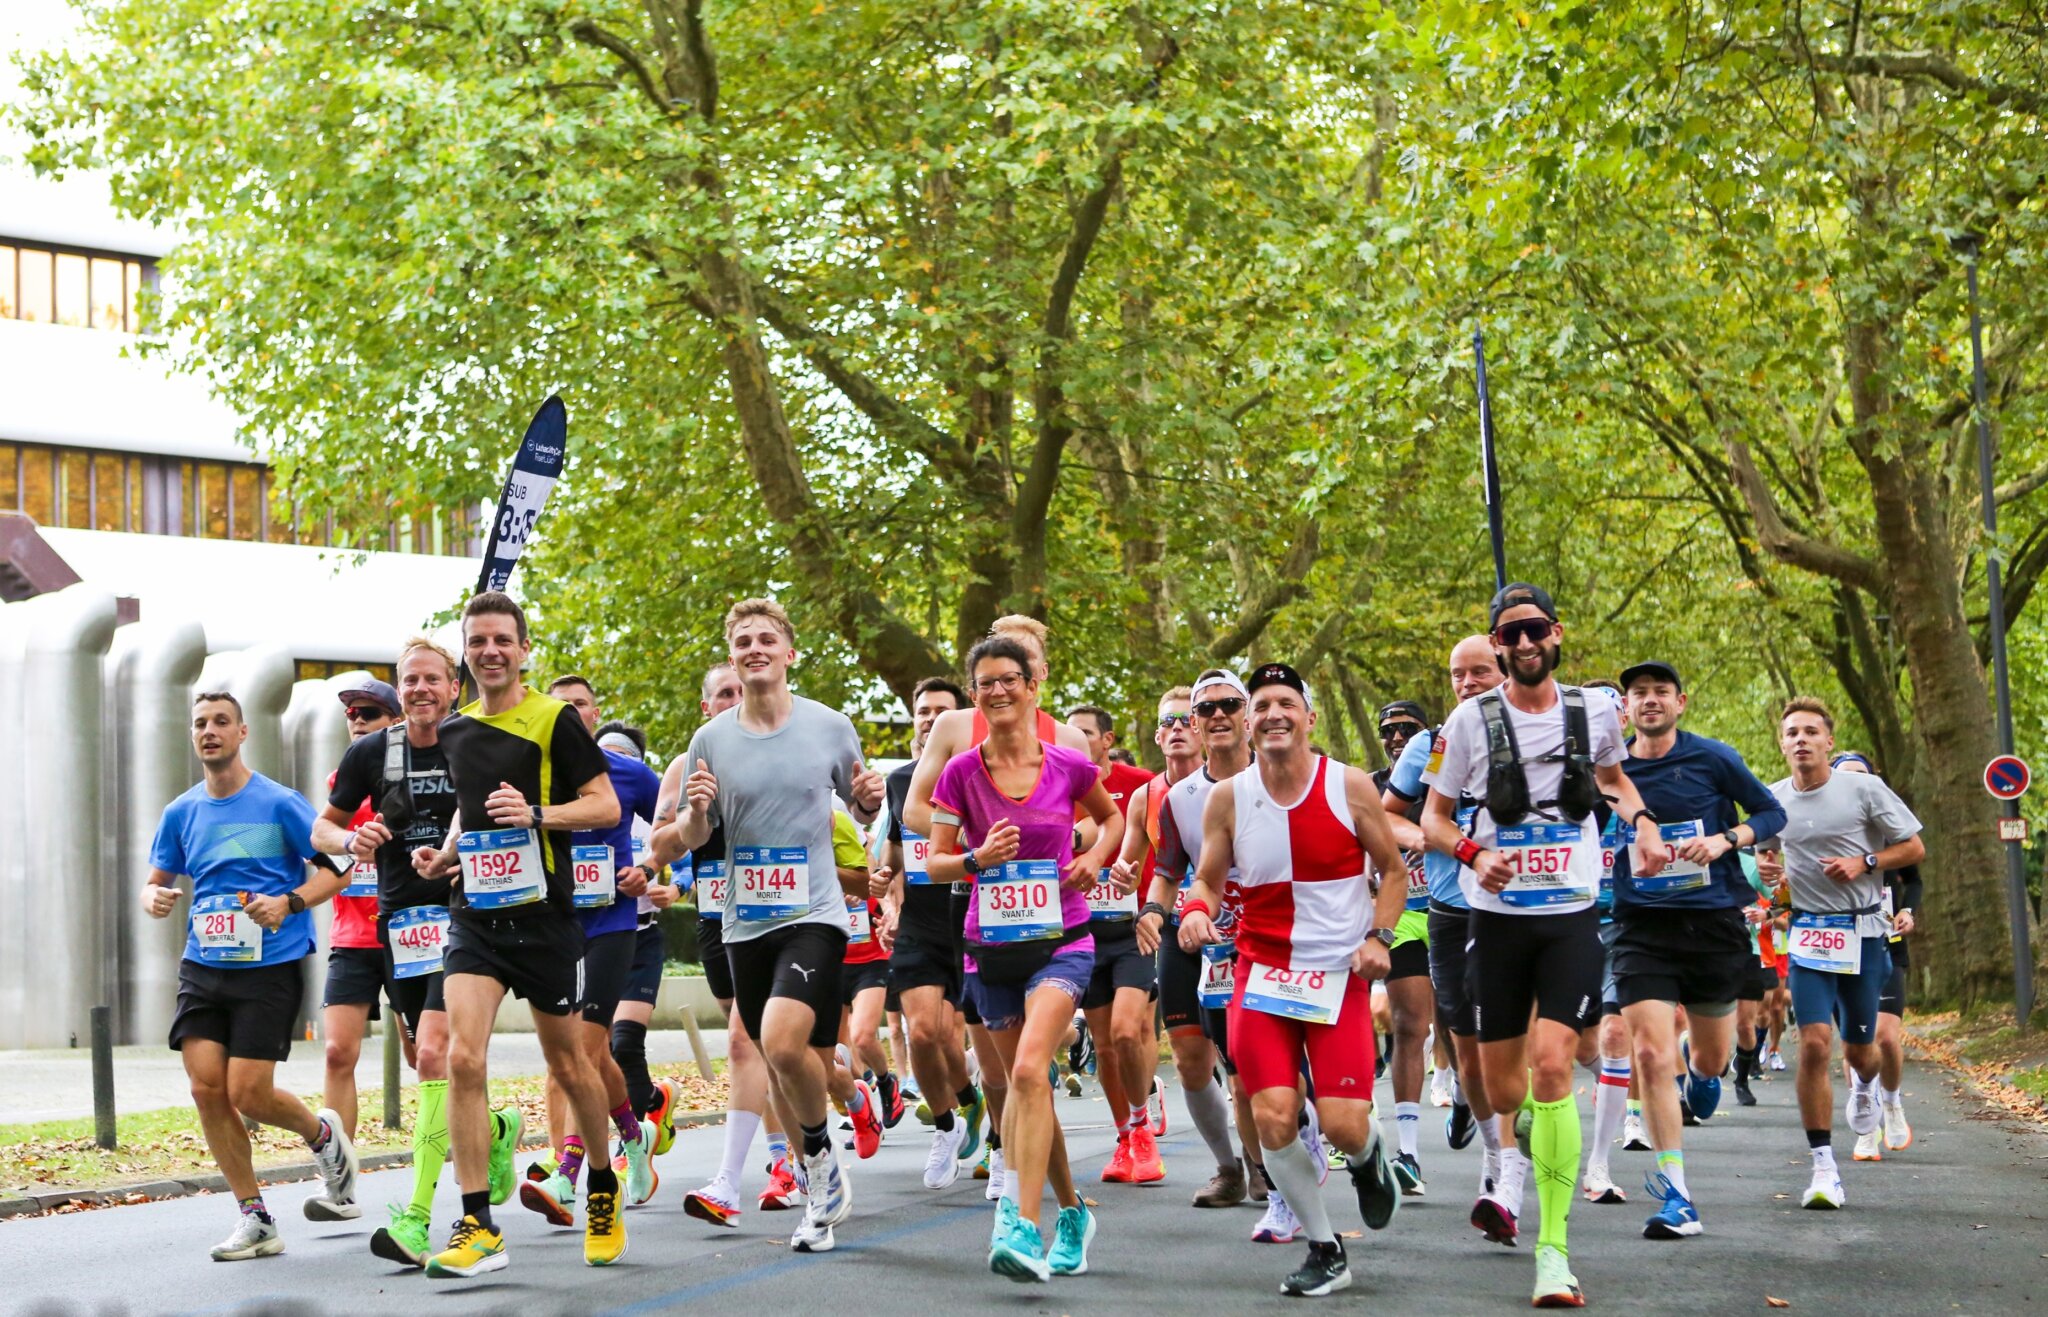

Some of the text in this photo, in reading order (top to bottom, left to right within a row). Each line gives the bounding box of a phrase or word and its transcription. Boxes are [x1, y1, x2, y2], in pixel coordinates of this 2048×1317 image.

[508, 483, 527, 500] SUB
[469, 851, 522, 878] 1592
[1516, 847, 1572, 874] 1557
[479, 876, 513, 886] MATTHIAS
[744, 868, 797, 891] 3144
[756, 891, 782, 899] MORITZ
[990, 883, 1048, 910] 3310
[1001, 909, 1036, 919] SVANTJE
[204, 913, 235, 935] 281
[399, 925, 441, 948] 4494
[1799, 929, 1845, 950] 2266
[1811, 947, 1831, 956] JONAS
[1205, 980, 1234, 989] MARKUS
[1278, 983, 1303, 995] ROGER
